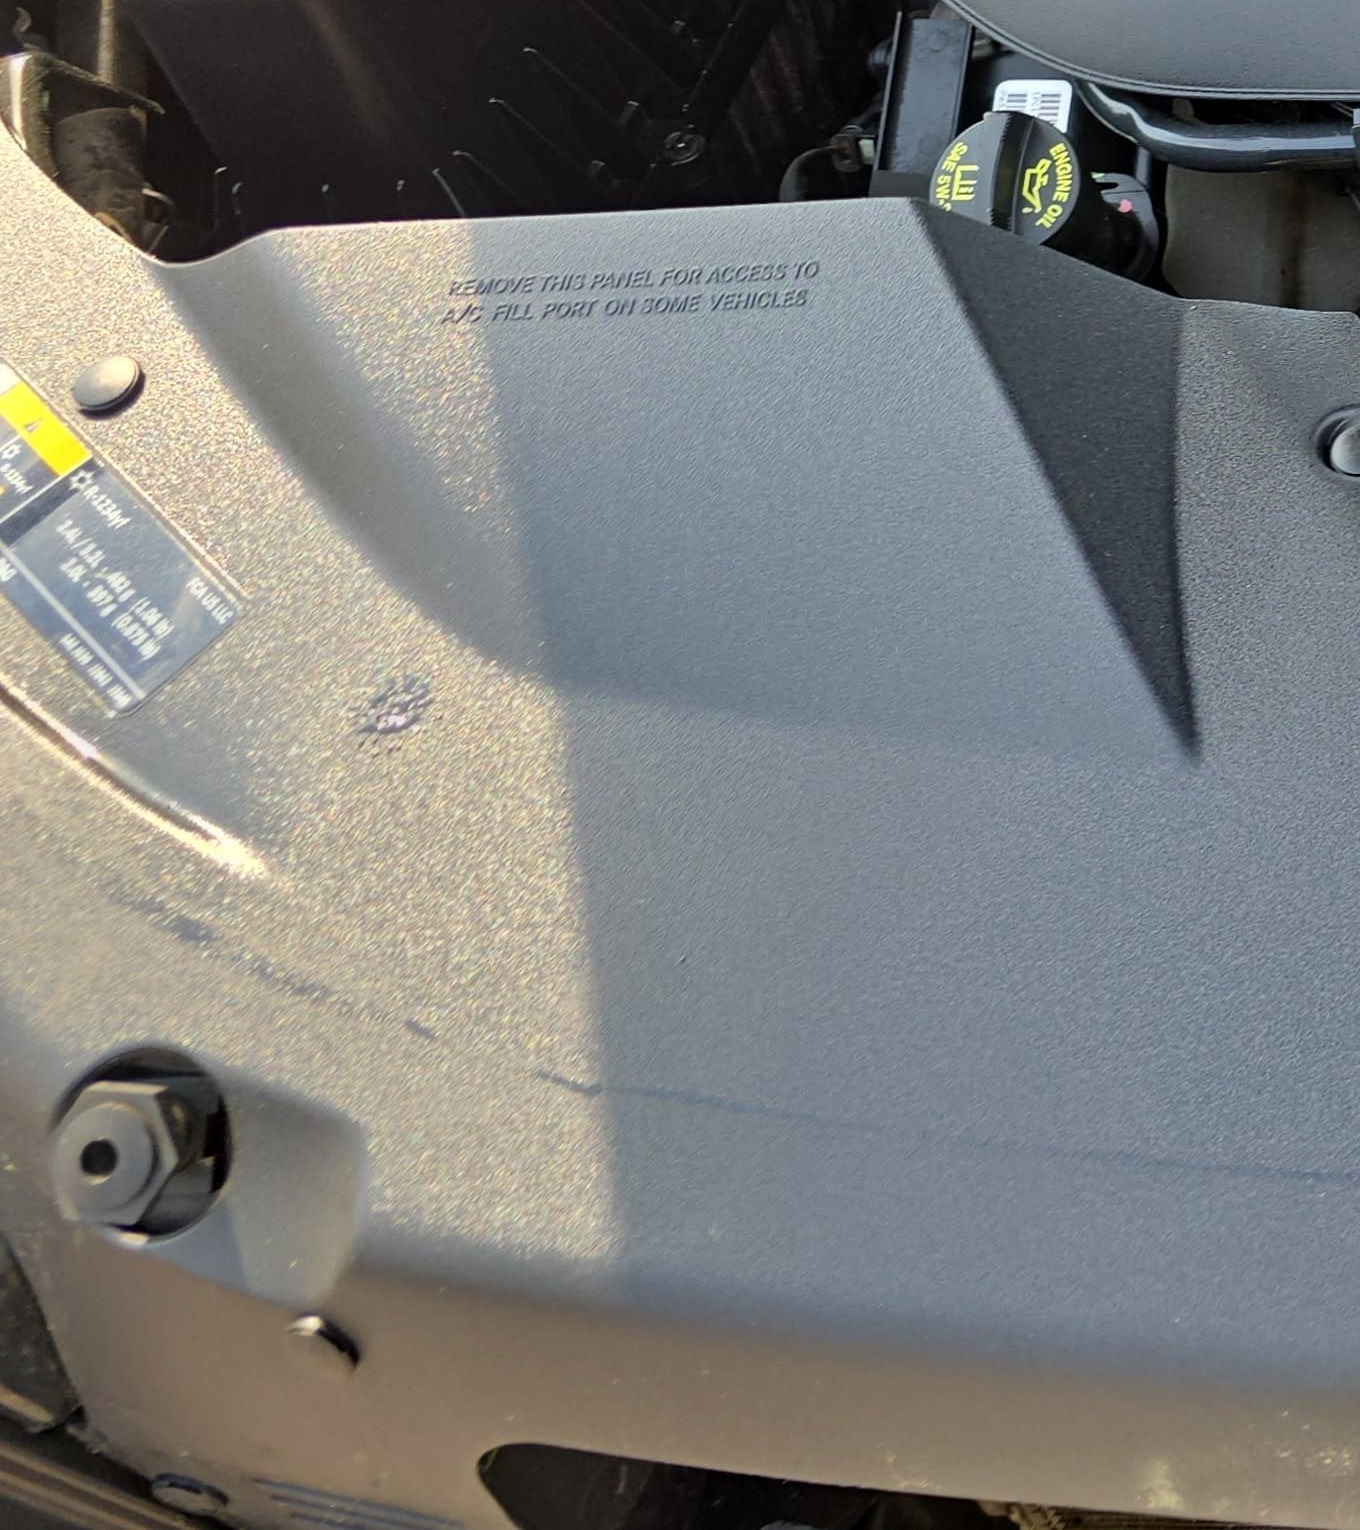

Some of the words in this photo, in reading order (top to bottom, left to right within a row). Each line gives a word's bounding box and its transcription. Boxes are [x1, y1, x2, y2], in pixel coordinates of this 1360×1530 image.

[941, 141, 968, 172] SAE
[1049, 142, 1073, 203] ENGINE
[1035, 204, 1063, 228] OIL
[449, 276, 537, 296] REMOVE
[540, 273, 586, 293] THIS
[590, 269, 654, 290] PANEL
[659, 267, 702, 286] FOR
[705, 263, 787, 285] ACCESS
[792, 261, 820, 280] TO
[440, 304, 485, 325] A/C
[491, 301, 535, 321] FILL
[541, 298, 599, 320] PORT
[604, 297, 637, 318] ON
[642, 294, 703, 315] SOME
[709, 289, 808, 312] VEHICLES
[186, 577, 208, 600] FCA
[200, 592, 221, 611] US
[211, 604, 235, 625] LLC
